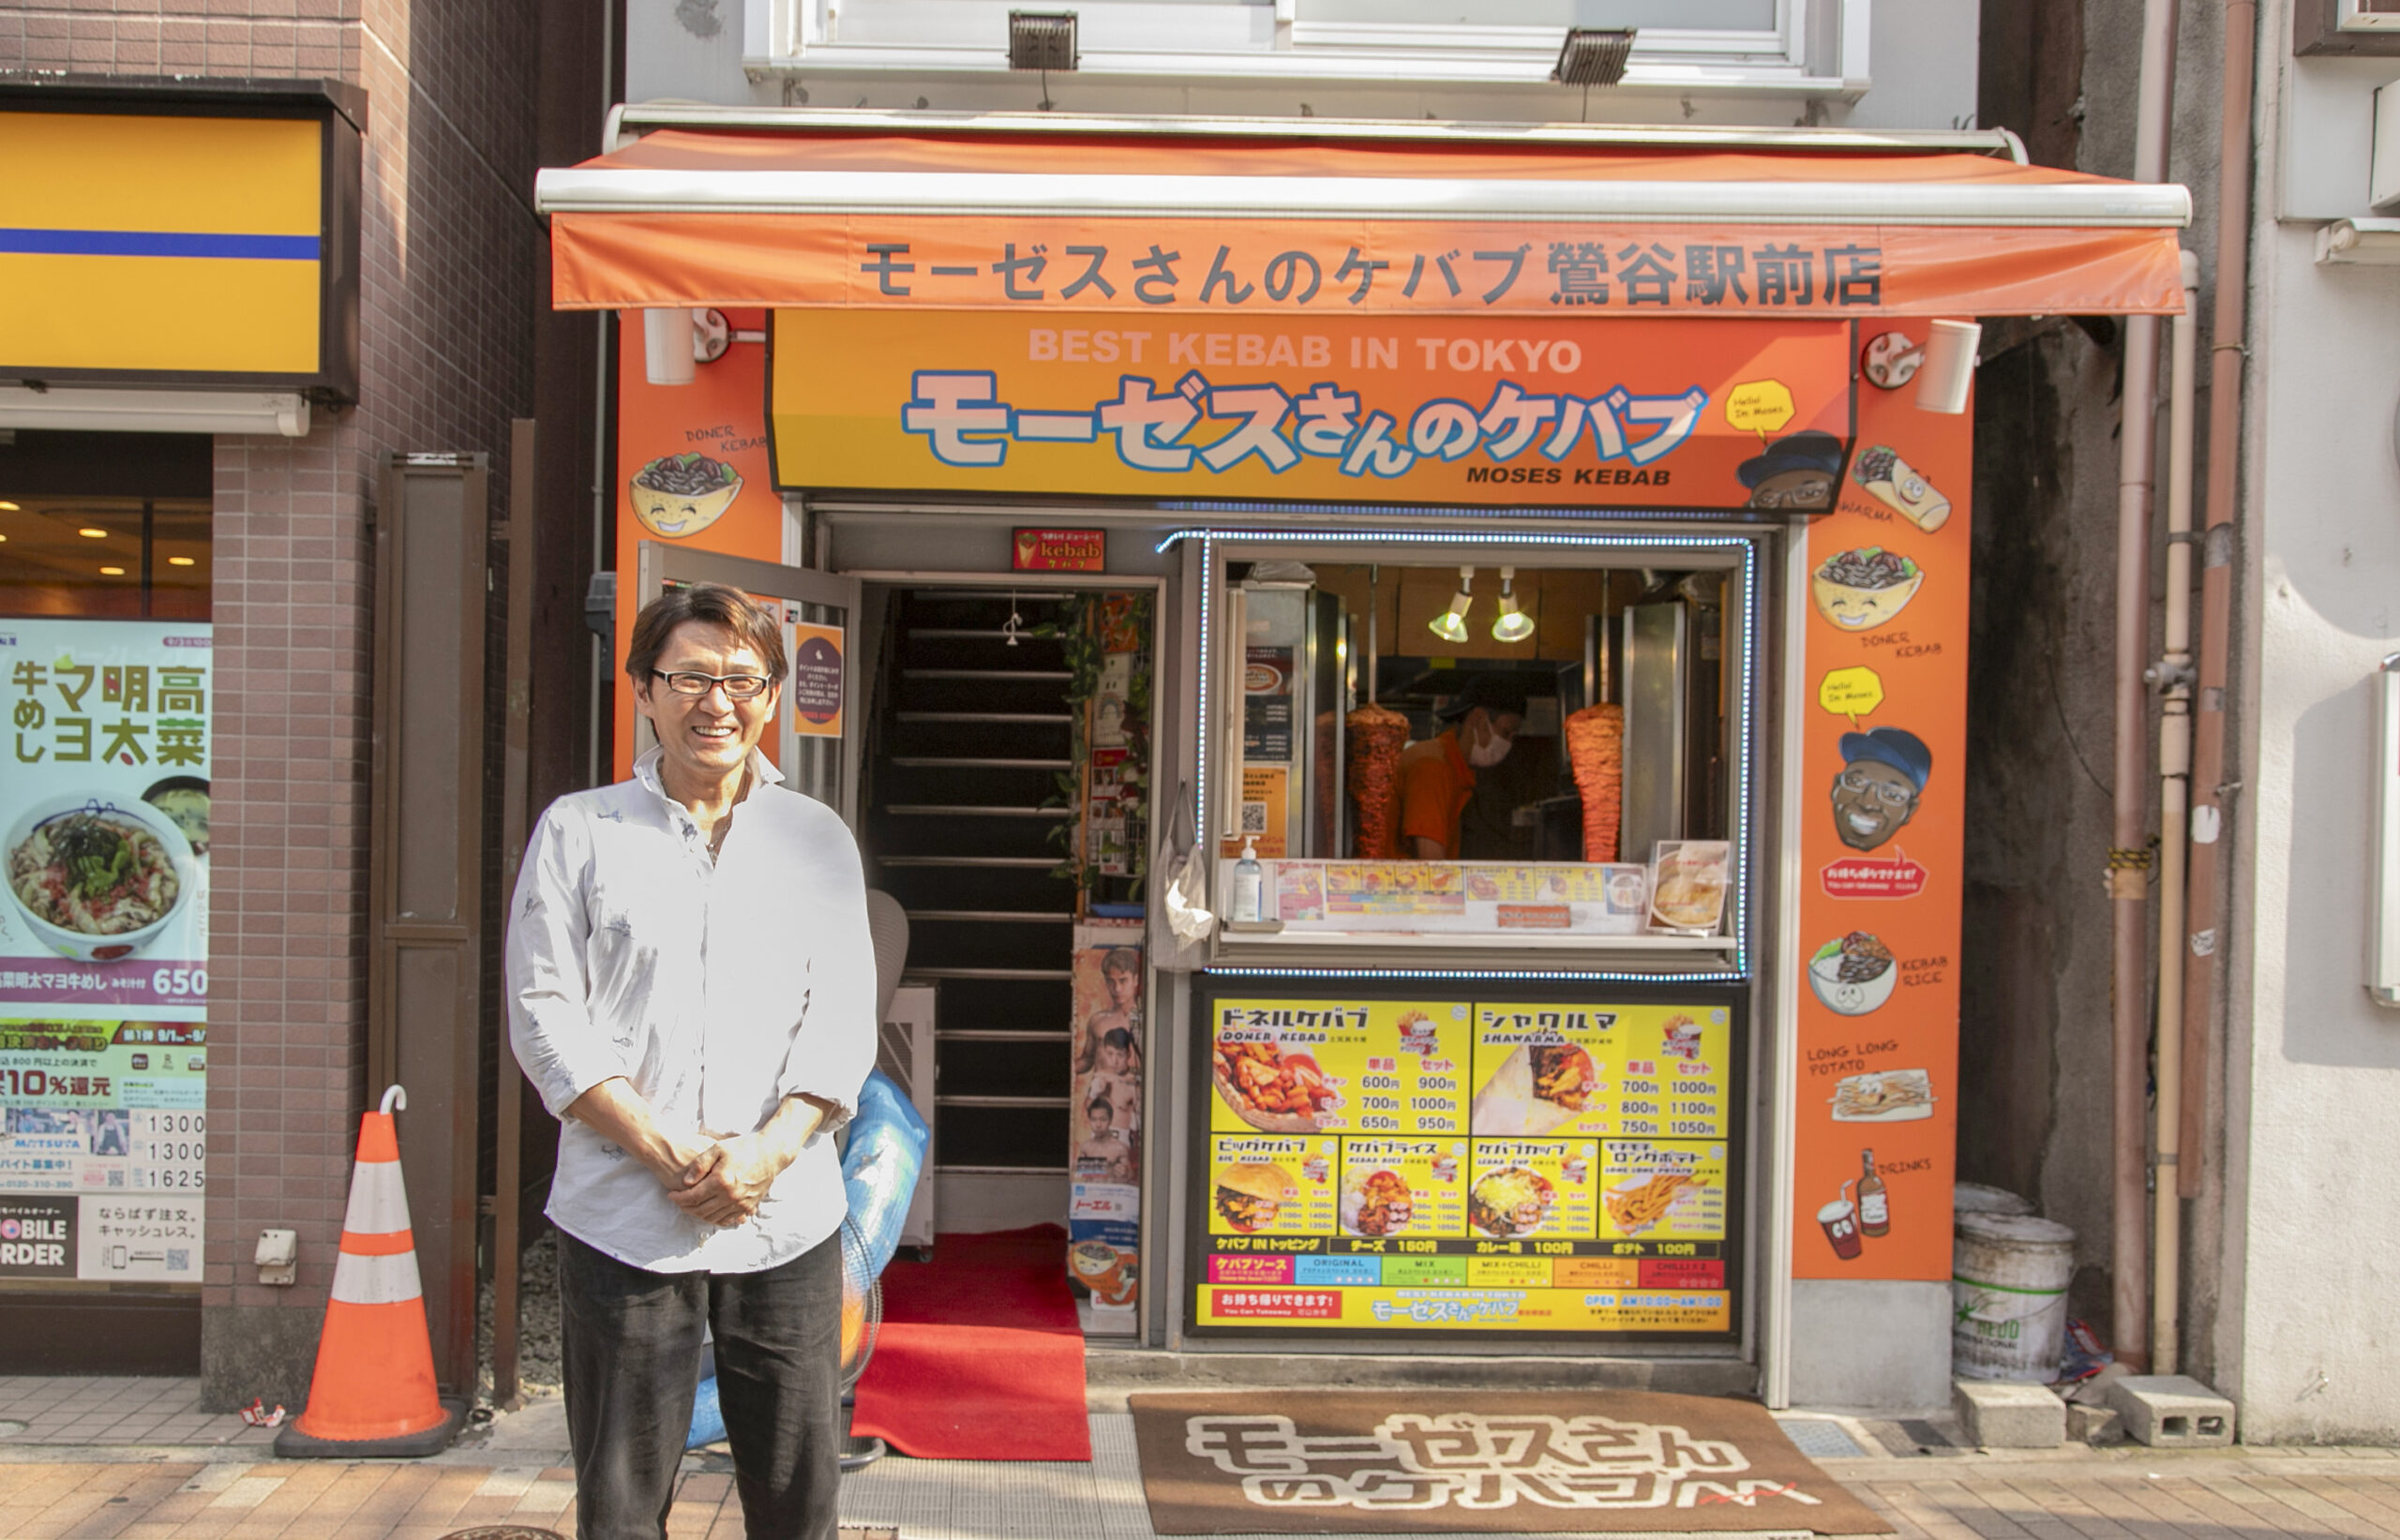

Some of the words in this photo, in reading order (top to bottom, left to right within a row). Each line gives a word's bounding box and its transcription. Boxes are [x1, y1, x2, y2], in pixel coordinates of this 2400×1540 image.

[859, 241, 1882, 307] モーゼスさんのケバブ鶯谷駅前店
[1028, 328, 1152, 364] BEST
[1167, 331, 1332, 368] KEBAB
[1348, 336, 1399, 369] IN
[1416, 336, 1582, 374] TOKYO
[901, 369, 1710, 479] モーゼスさんのケバブ
[683, 424, 736, 442] DONER
[720, 436, 767, 453] KEBAB
[1465, 465, 1563, 486] MOSES
[1573, 468, 1672, 487] KEBAB
[1040, 541, 1102, 559] kebab
[1861, 631, 1911, 648] DONER
[1895, 643, 1942, 659] KEBAB
[12, 660, 48, 764] 牛めし
[53, 665, 96, 762] マヨ
[101, 665, 150, 766] 明太
[157, 665, 205, 767] 高菜
[1901, 955, 1949, 972] KEBAB
[152, 967, 209, 996] 650
[1902, 971, 1943, 987] RICE
[1222, 1006, 1369, 1028] ドネルケバブ
[1482, 1011, 1616, 1029] シャワルマ
[1222, 1031, 1270, 1041] DONER
[1278, 1032, 1327, 1042] KEBAB
[1482, 1033, 1566, 1043] SHAWARMA
[1807, 1044, 1851, 1062] LONG
[1856, 1039, 1900, 1056] LONG
[1367, 1057, 1395, 1071] 単品
[1420, 1057, 1454, 1072] セット
[1627, 1060, 1655, 1074] 単品
[1677, 1061, 1711, 1075] セット
[1808, 1058, 1867, 1077] POTATO
[1361, 1075, 1400, 1090] 600円
[1418, 1076, 1456, 1091] 900円
[1621, 1080, 1658, 1094] 700円
[1670, 1081, 1717, 1095] 1000円
[1361, 1096, 1399, 1110] 700円
[1410, 1097, 1456, 1111] 1000円
[1621, 1101, 1658, 1115] 800円
[1670, 1102, 1716, 1116] 1100円
[149, 1114, 205, 1133] 1300
[1360, 1115, 1399, 1129] 650円
[1418, 1116, 1455, 1130] 950円
[1621, 1120, 1658, 1134] 750円
[1670, 1121, 1716, 1135] 1050円
[149, 1143, 204, 1161] 1300
[1218, 1138, 1306, 1152] ビッグケバブ
[1348, 1140, 1437, 1154] ケバブライス
[1478, 1142, 1568, 1155] ケバブカップ
[1877, 1158, 1933, 1175] DRINKS
[149, 1169, 204, 1188] 1625
[98, 1206, 197, 1223] ならばず注文。
[0, 1219, 68, 1241] OBILE
[98, 1224, 197, 1240] キャッシュレス。
[1350, 1239, 1386, 1252] チーズ
[1534, 1240, 1573, 1254] 100円
[1612, 1241, 1644, 1254] ポテト
[1657, 1242, 1695, 1255] 100円
[0, 1243, 66, 1266] RDER
[1312, 1258, 1364, 1266] ORIGINAL
[1216, 1257, 1287, 1270] ケバブソース
[1221, 1293, 1333, 1307] お持ち帰りできます!
[1583, 1294, 1615, 1306] OPEN
[1371, 1299, 1519, 1322] モーゼスさんのケバブ
[1187, 1413, 1751, 1475] モーゼスさん
[1242, 1470, 1673, 1511] のケバブ
